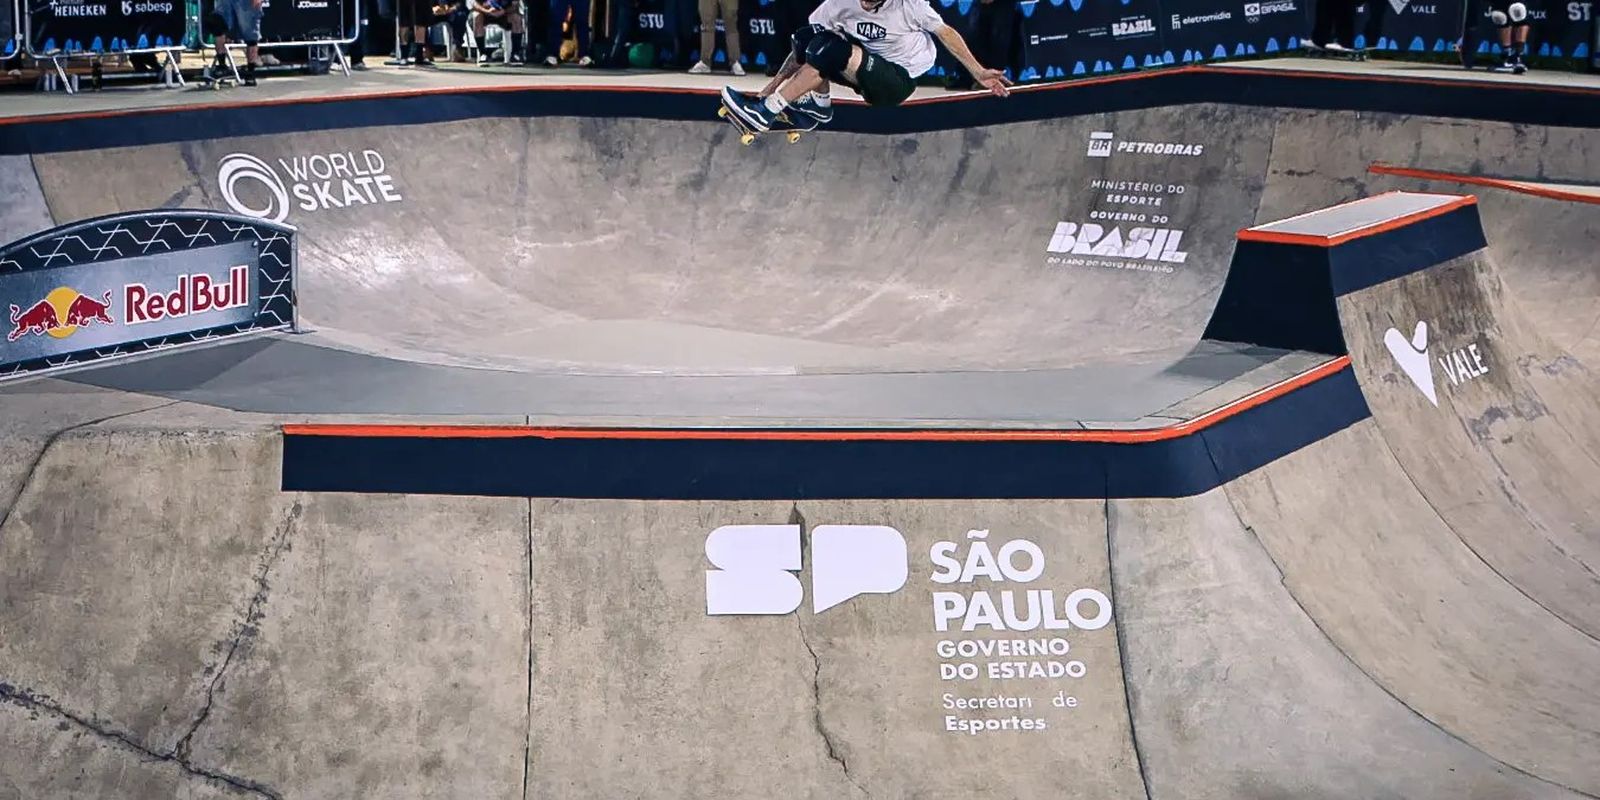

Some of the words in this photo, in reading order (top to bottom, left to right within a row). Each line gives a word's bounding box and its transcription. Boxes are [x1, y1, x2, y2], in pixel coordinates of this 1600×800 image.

[55, 5, 106, 16] HEINEKEN
[135, 0, 173, 14] sabesp
[1411, 5, 1437, 13] VALE
[1567, 2, 1593, 21] ST
[639, 14, 664, 28] STU
[750, 19, 775, 34] STU
[1182, 12, 1232, 24] eletromidia
[858, 24, 885, 38] VANS
[1112, 19, 1156, 36] BRASIL
[1117, 141, 1203, 156] PETROBRAS
[278, 150, 385, 182] WORLD
[292, 174, 402, 212] SKATE
[1091, 180, 1163, 193] MINISTÉRIO
[1167, 184, 1185, 194] DO
[1106, 194, 1163, 206] ESPORTE
[1090, 211, 1146, 222] GOVERNO
[1151, 215, 1168, 224] DO
[1046, 221, 1188, 263] BRASIL
[124, 275, 189, 325] Red
[190, 265, 250, 313] Bull
[1438, 343, 1489, 386] VALE
[929, 529, 1045, 583] SÃO
[932, 588, 1112, 631] PAULO
[936, 638, 1070, 658] GOVERNO
[940, 663, 979, 680] DO
[987, 661, 1087, 679] ESTADO
[1052, 691, 1078, 708] de
[945, 715, 1047, 735] Esportes
